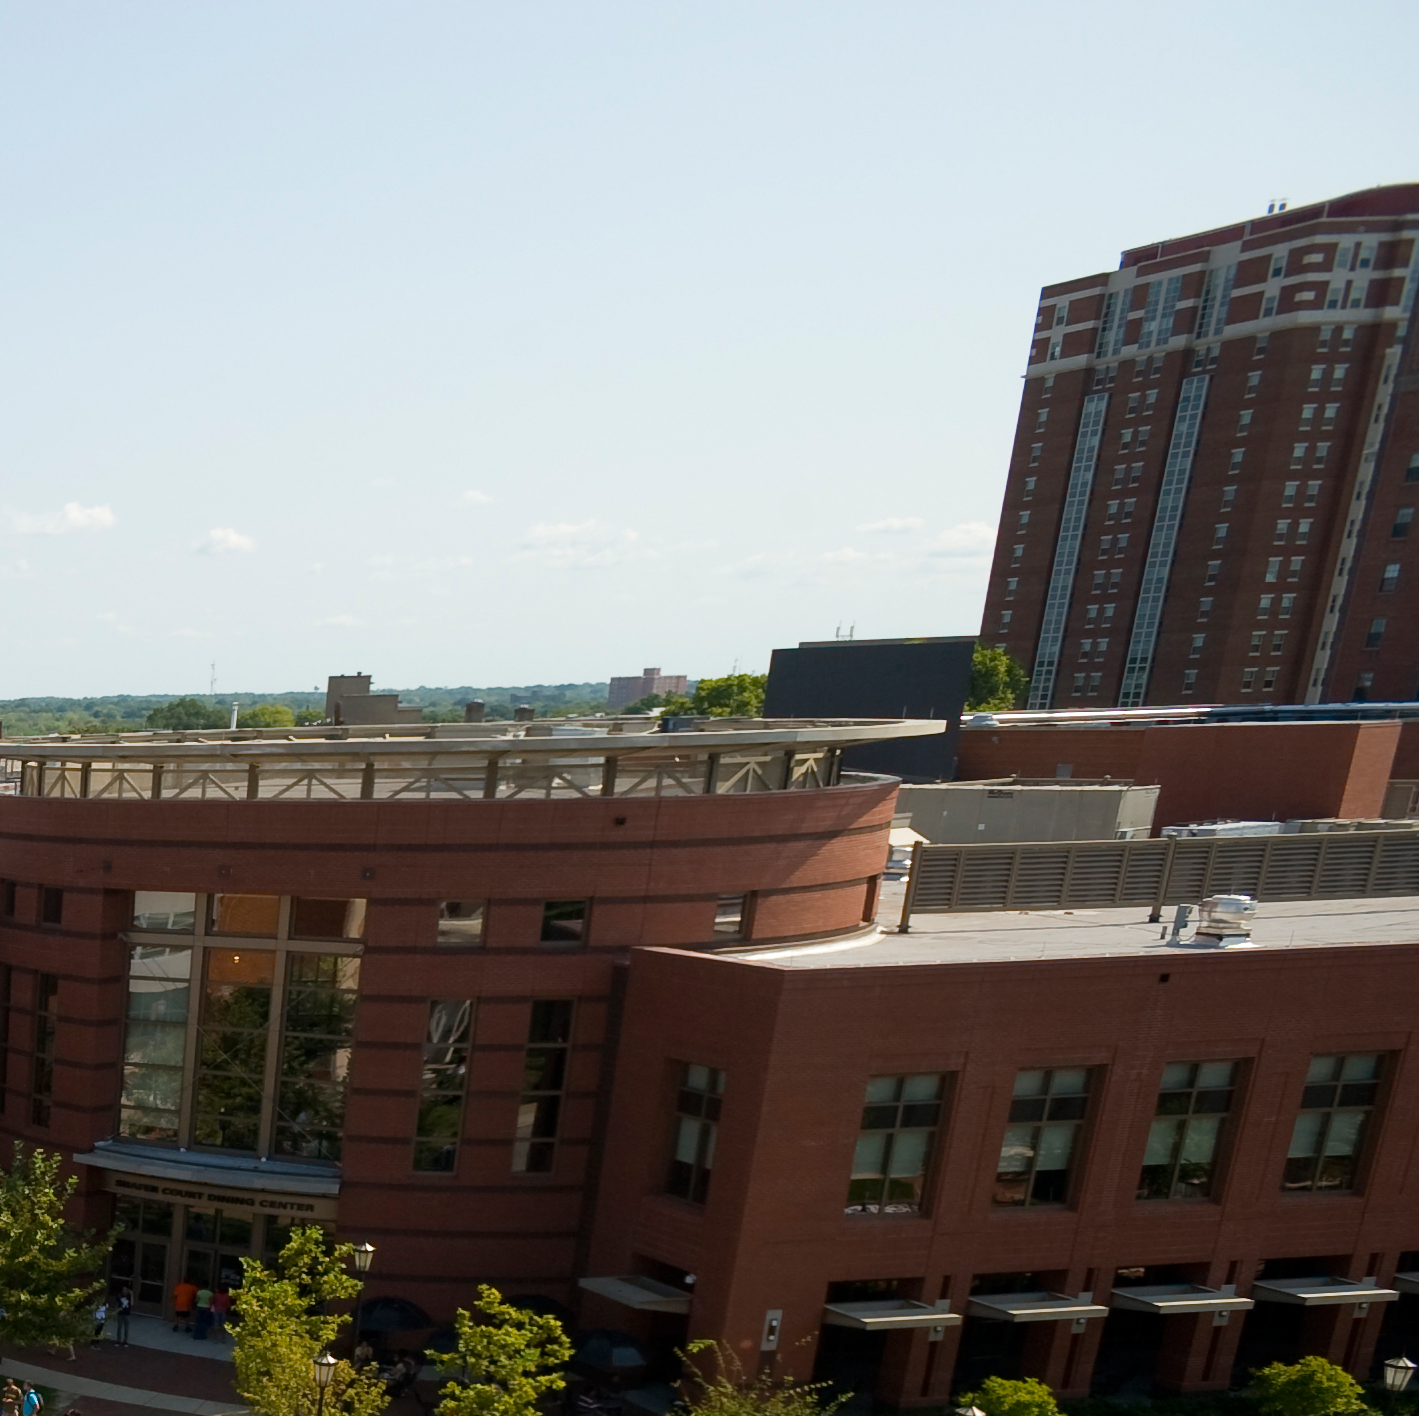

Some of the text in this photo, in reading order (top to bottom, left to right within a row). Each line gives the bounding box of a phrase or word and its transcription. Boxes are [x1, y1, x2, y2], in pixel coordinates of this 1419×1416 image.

[115, 1179, 315, 1213] SHAFER COURT DINING CENTER
